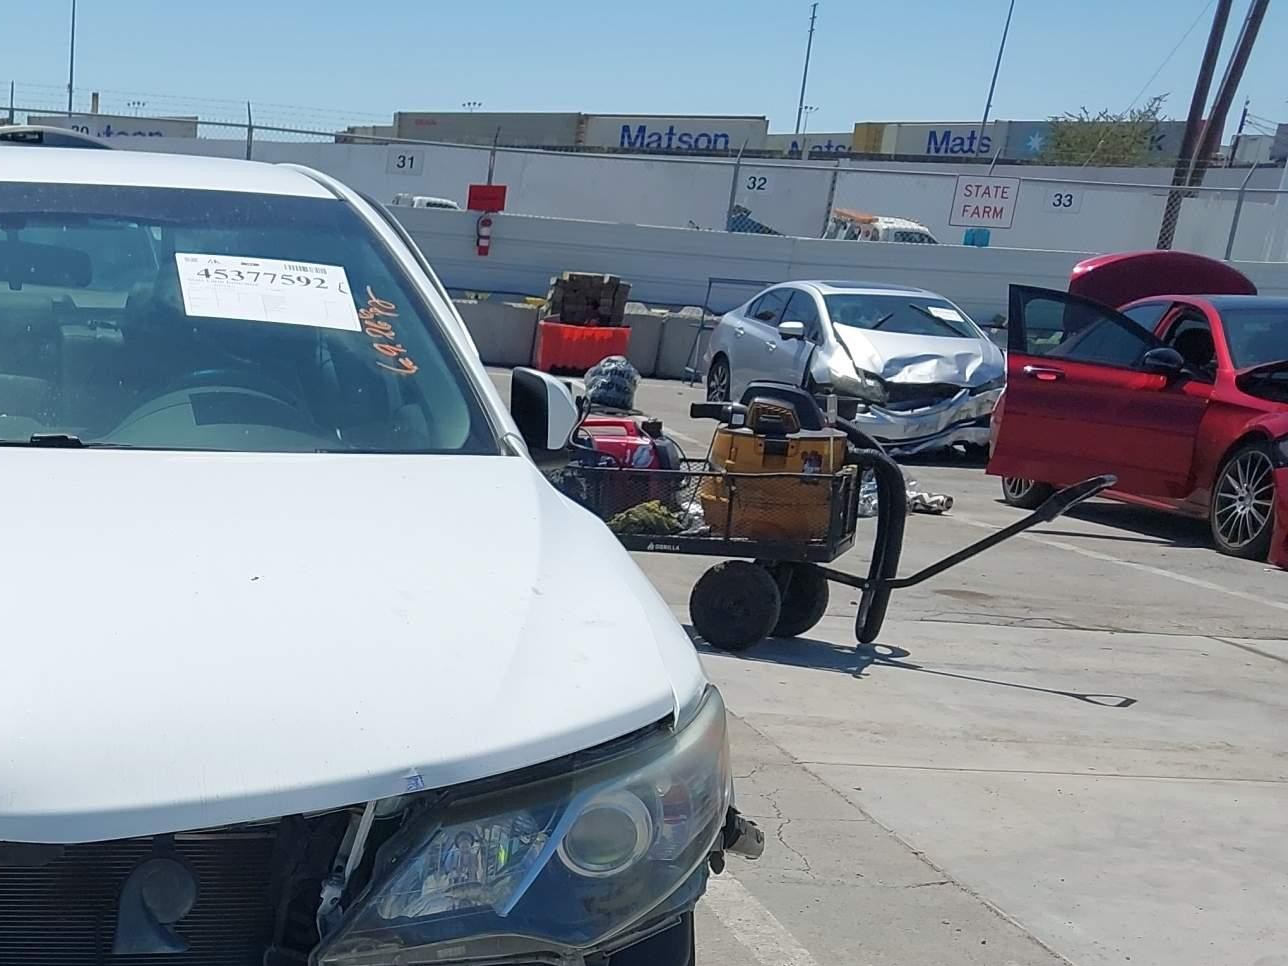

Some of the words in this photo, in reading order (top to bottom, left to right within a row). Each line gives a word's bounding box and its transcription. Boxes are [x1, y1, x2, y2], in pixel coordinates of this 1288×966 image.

[619, 125, 730, 151] Matson
[396, 155, 415, 169] 31
[746, 176, 767, 190] 32
[963, 184, 1010, 200] STATE
[1052, 193, 1074, 208] 33
[962, 204, 1004, 219] FARM
[197, 267, 329, 290] 45377592
